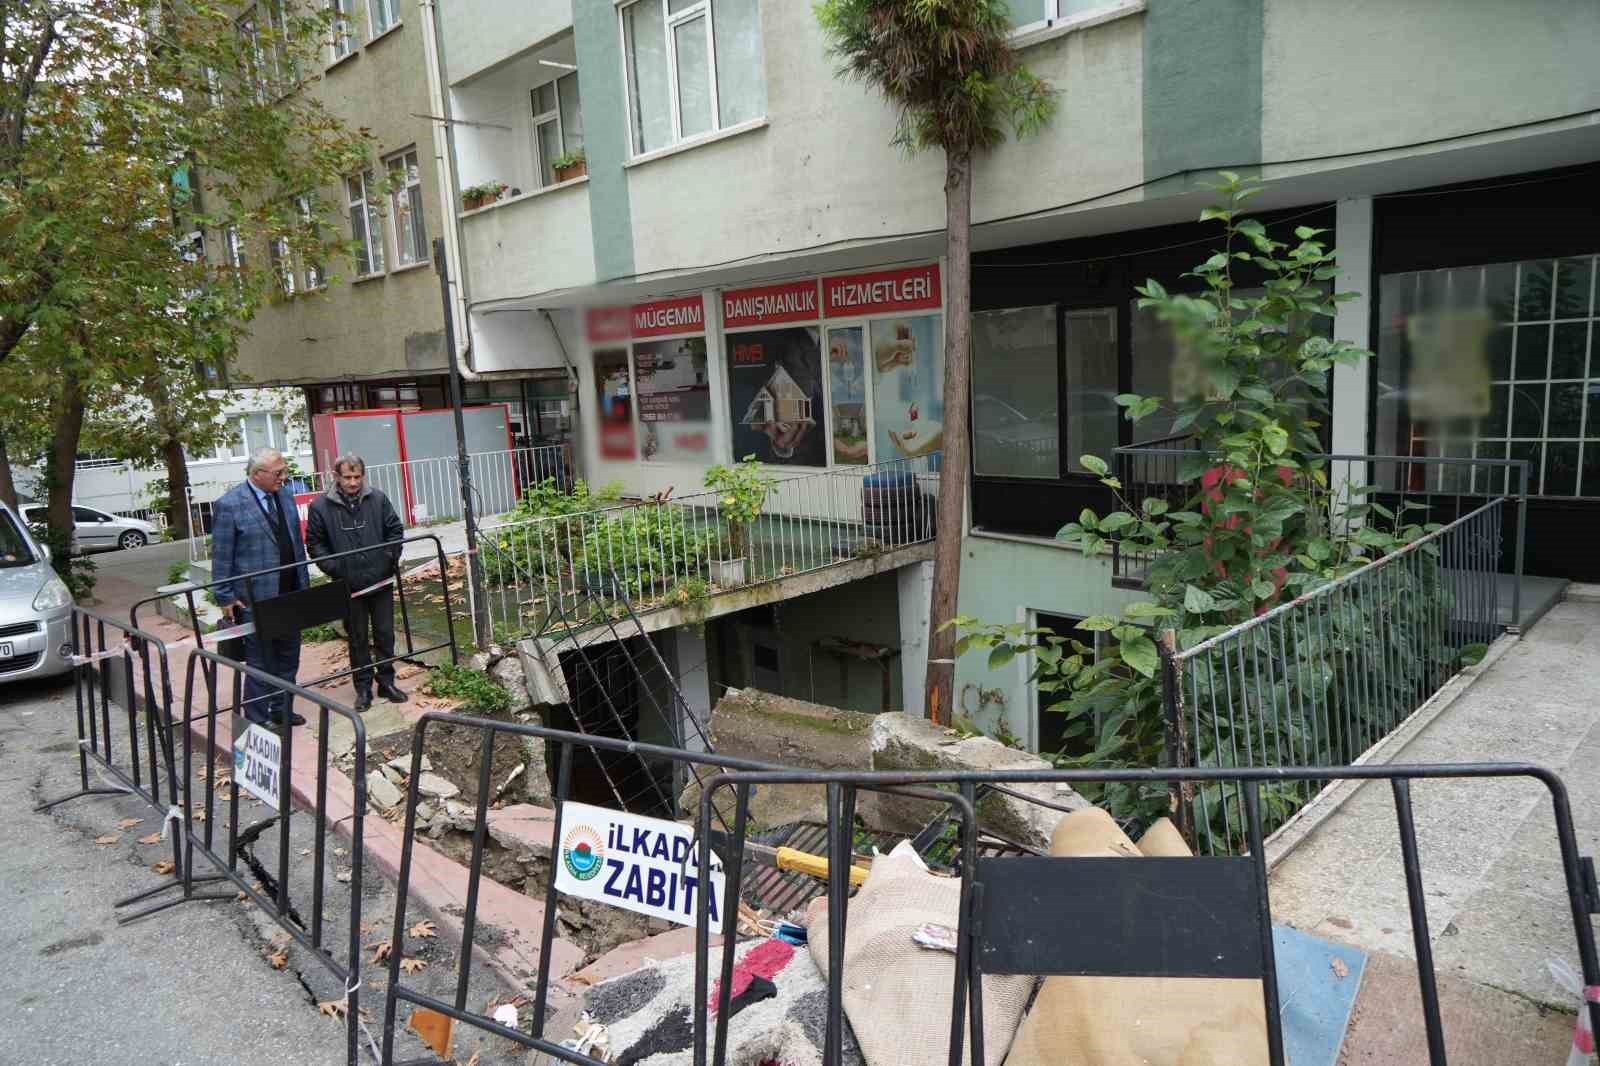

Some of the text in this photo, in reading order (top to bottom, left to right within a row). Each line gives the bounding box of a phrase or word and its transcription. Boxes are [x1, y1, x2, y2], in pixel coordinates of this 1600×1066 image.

[635, 305, 702, 330] MÜGEMM
[725, 290, 816, 319] DANIŞMANLIK
[831, 271, 932, 308] HİZMETLERİ
[607, 822, 720, 872] İLKAD
[603, 858, 720, 923] ZABITA
